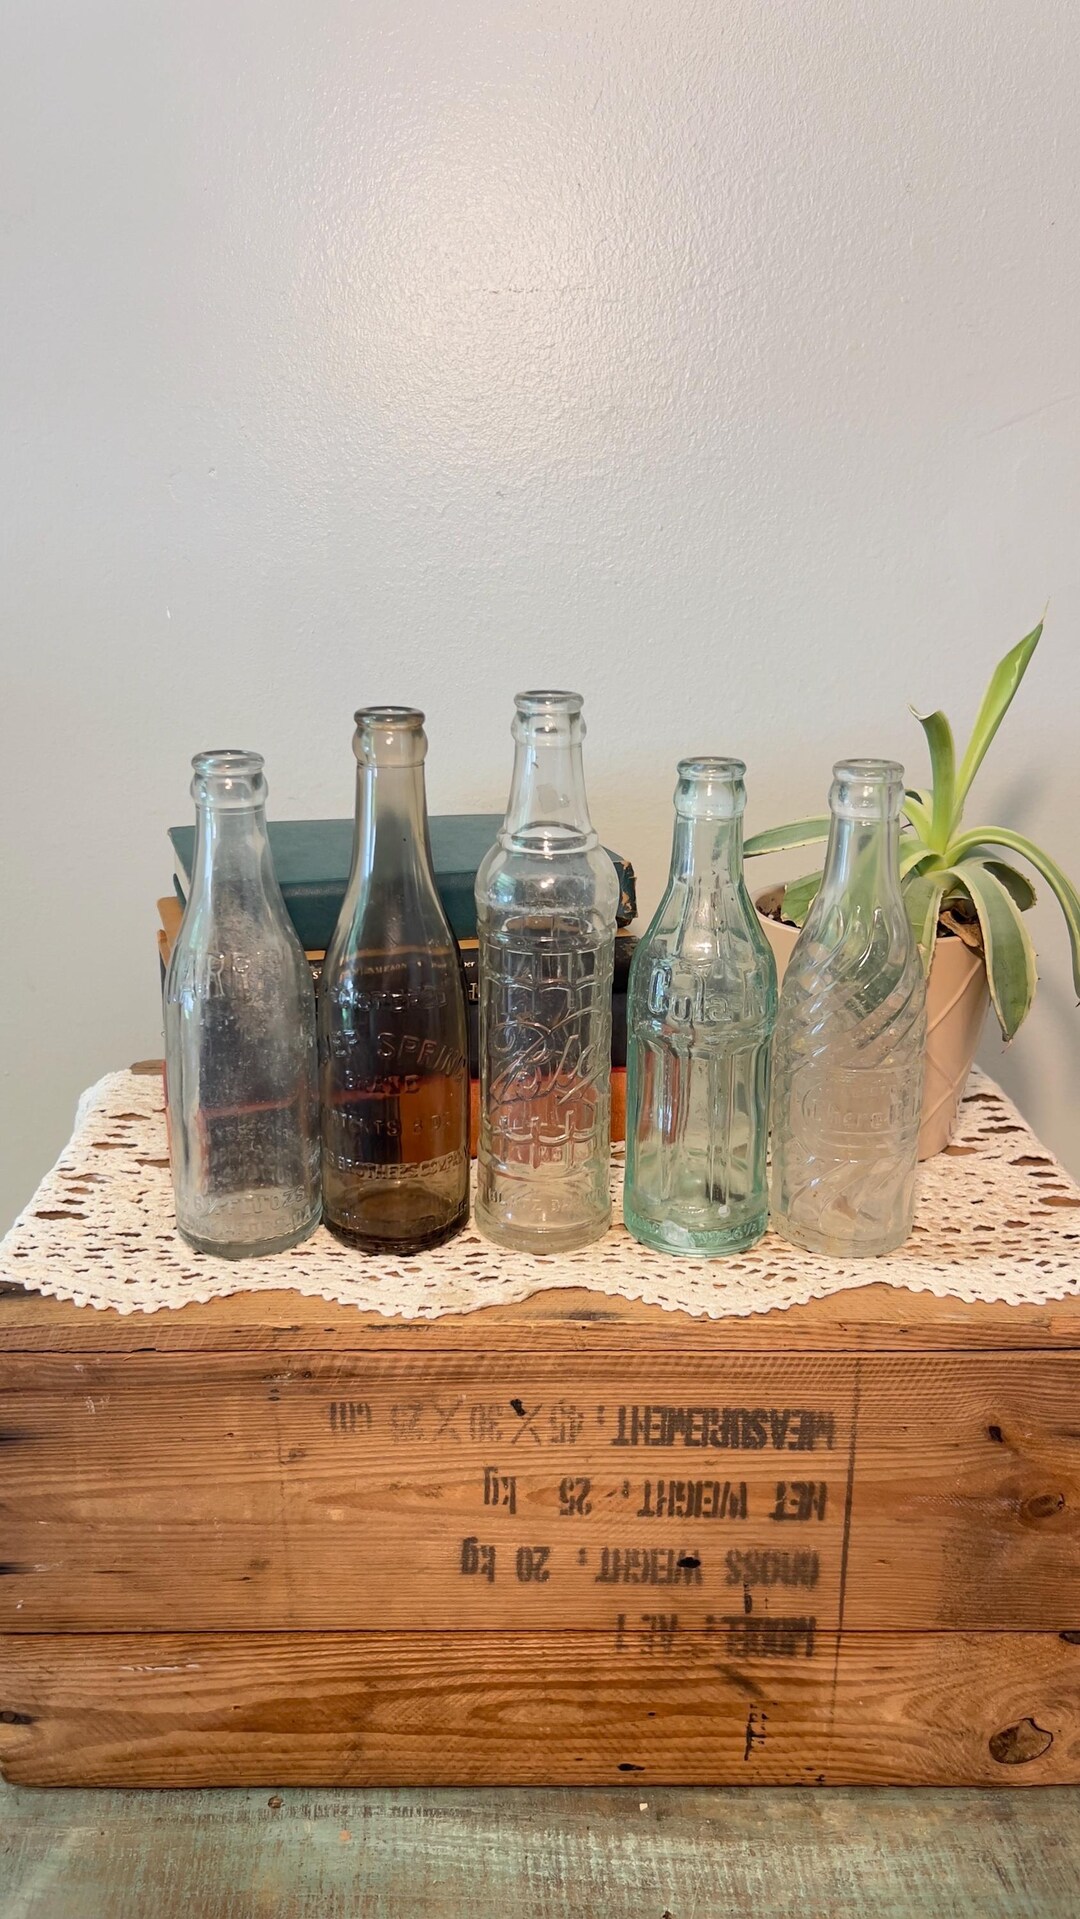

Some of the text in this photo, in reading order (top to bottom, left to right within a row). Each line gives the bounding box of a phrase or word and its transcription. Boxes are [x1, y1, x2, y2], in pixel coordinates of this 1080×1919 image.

[483, 1466, 517, 1515] kg
[558, 1476, 593, 1517] 25
[768, 1479, 829, 1522] NET
[460, 1536, 496, 1584] kg
[516, 1546, 550, 1583] 20
